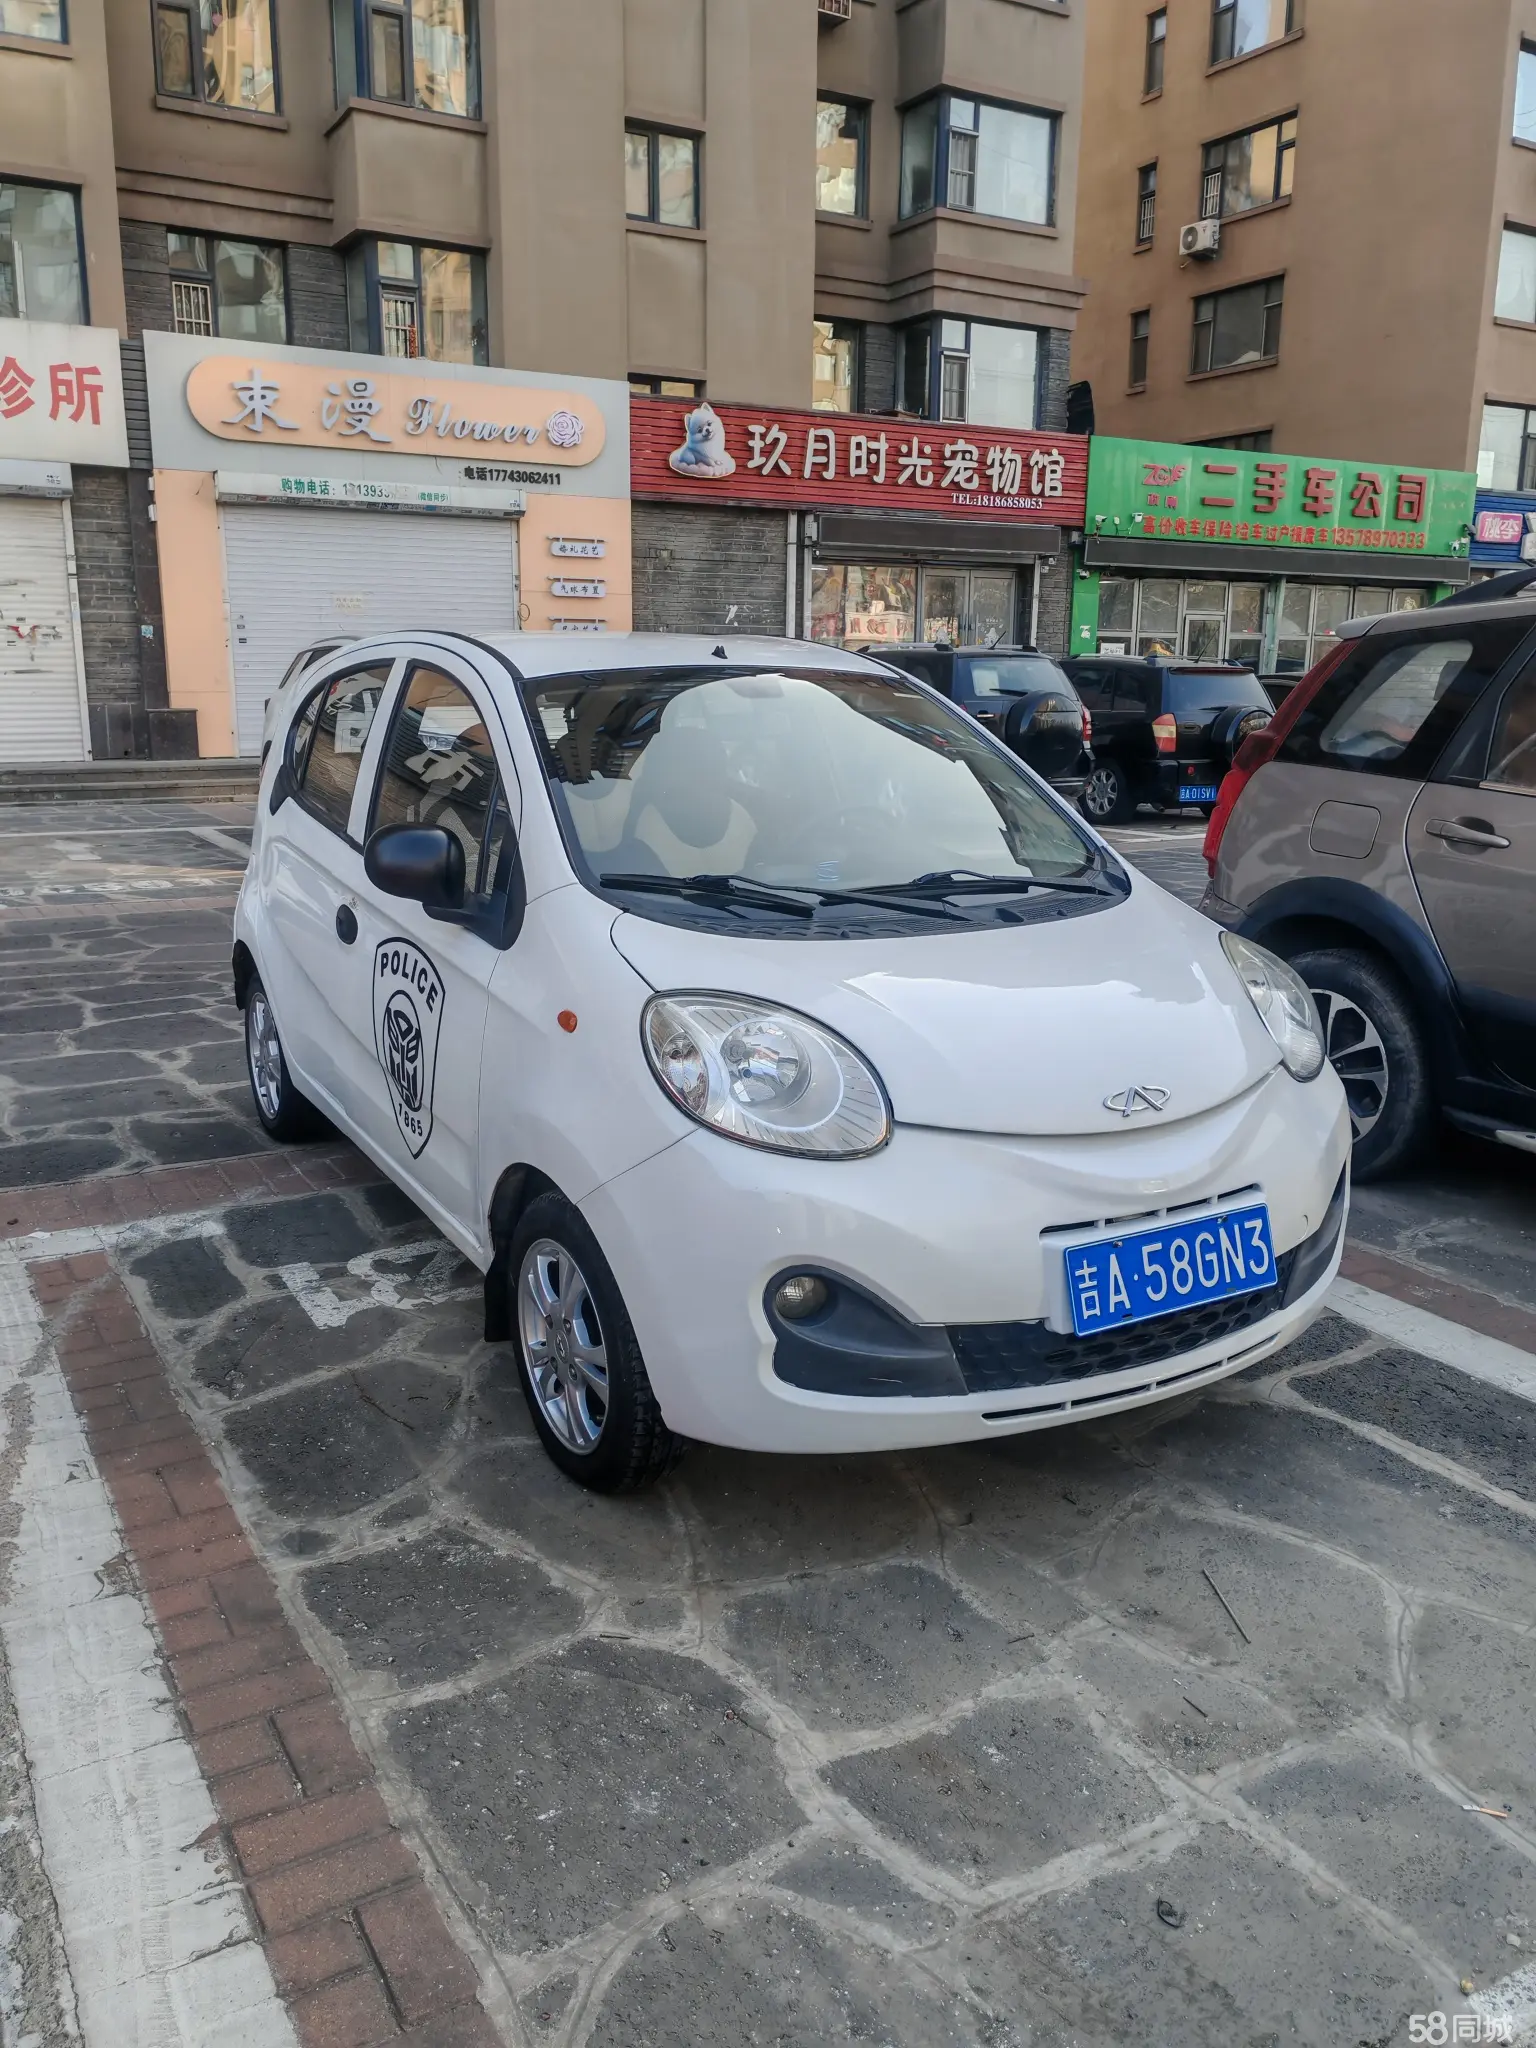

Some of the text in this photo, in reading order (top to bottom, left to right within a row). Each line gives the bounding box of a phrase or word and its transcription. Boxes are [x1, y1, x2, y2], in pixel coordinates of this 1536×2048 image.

[406, 397, 541, 446] Flower
[464, 465, 561, 486] 电话17743062411
[747, 423, 1065, 497] 玖月时光宠物馆
[951, 491, 1044, 510] TEL:18186858053
[1202, 462, 1427, 523] 二手车公司
[561, 584, 600, 595] 气球布置
[381, 950, 439, 1014] POLICE
[398, 1103, 424, 1137] 1865
